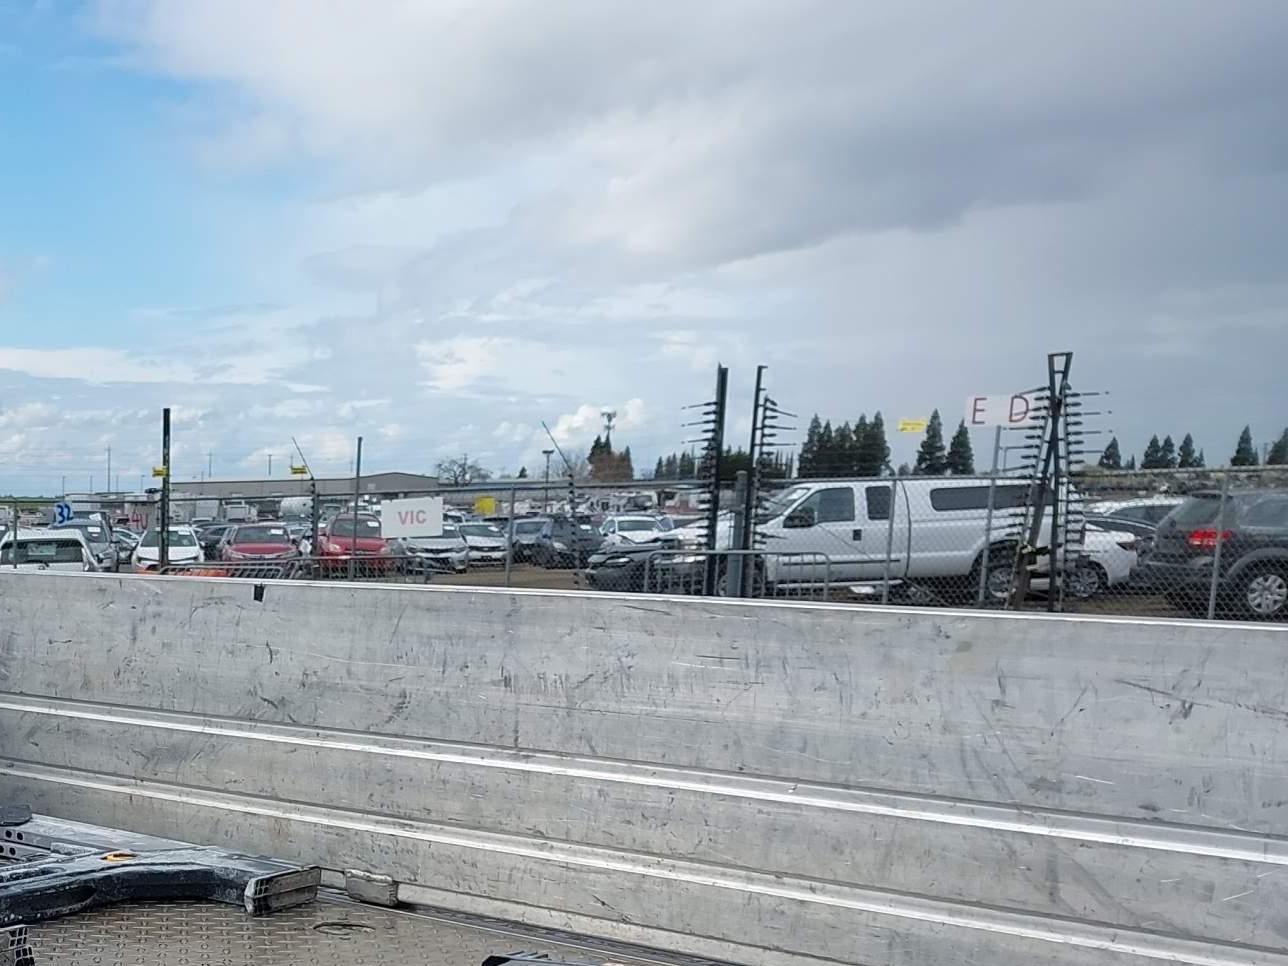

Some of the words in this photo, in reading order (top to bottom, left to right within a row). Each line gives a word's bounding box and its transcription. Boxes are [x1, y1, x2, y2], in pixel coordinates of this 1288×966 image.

[972, 397, 987, 424] E
[1009, 394, 1029, 423] D
[56, 503, 73, 524] 32
[398, 510, 427, 525] VIC
